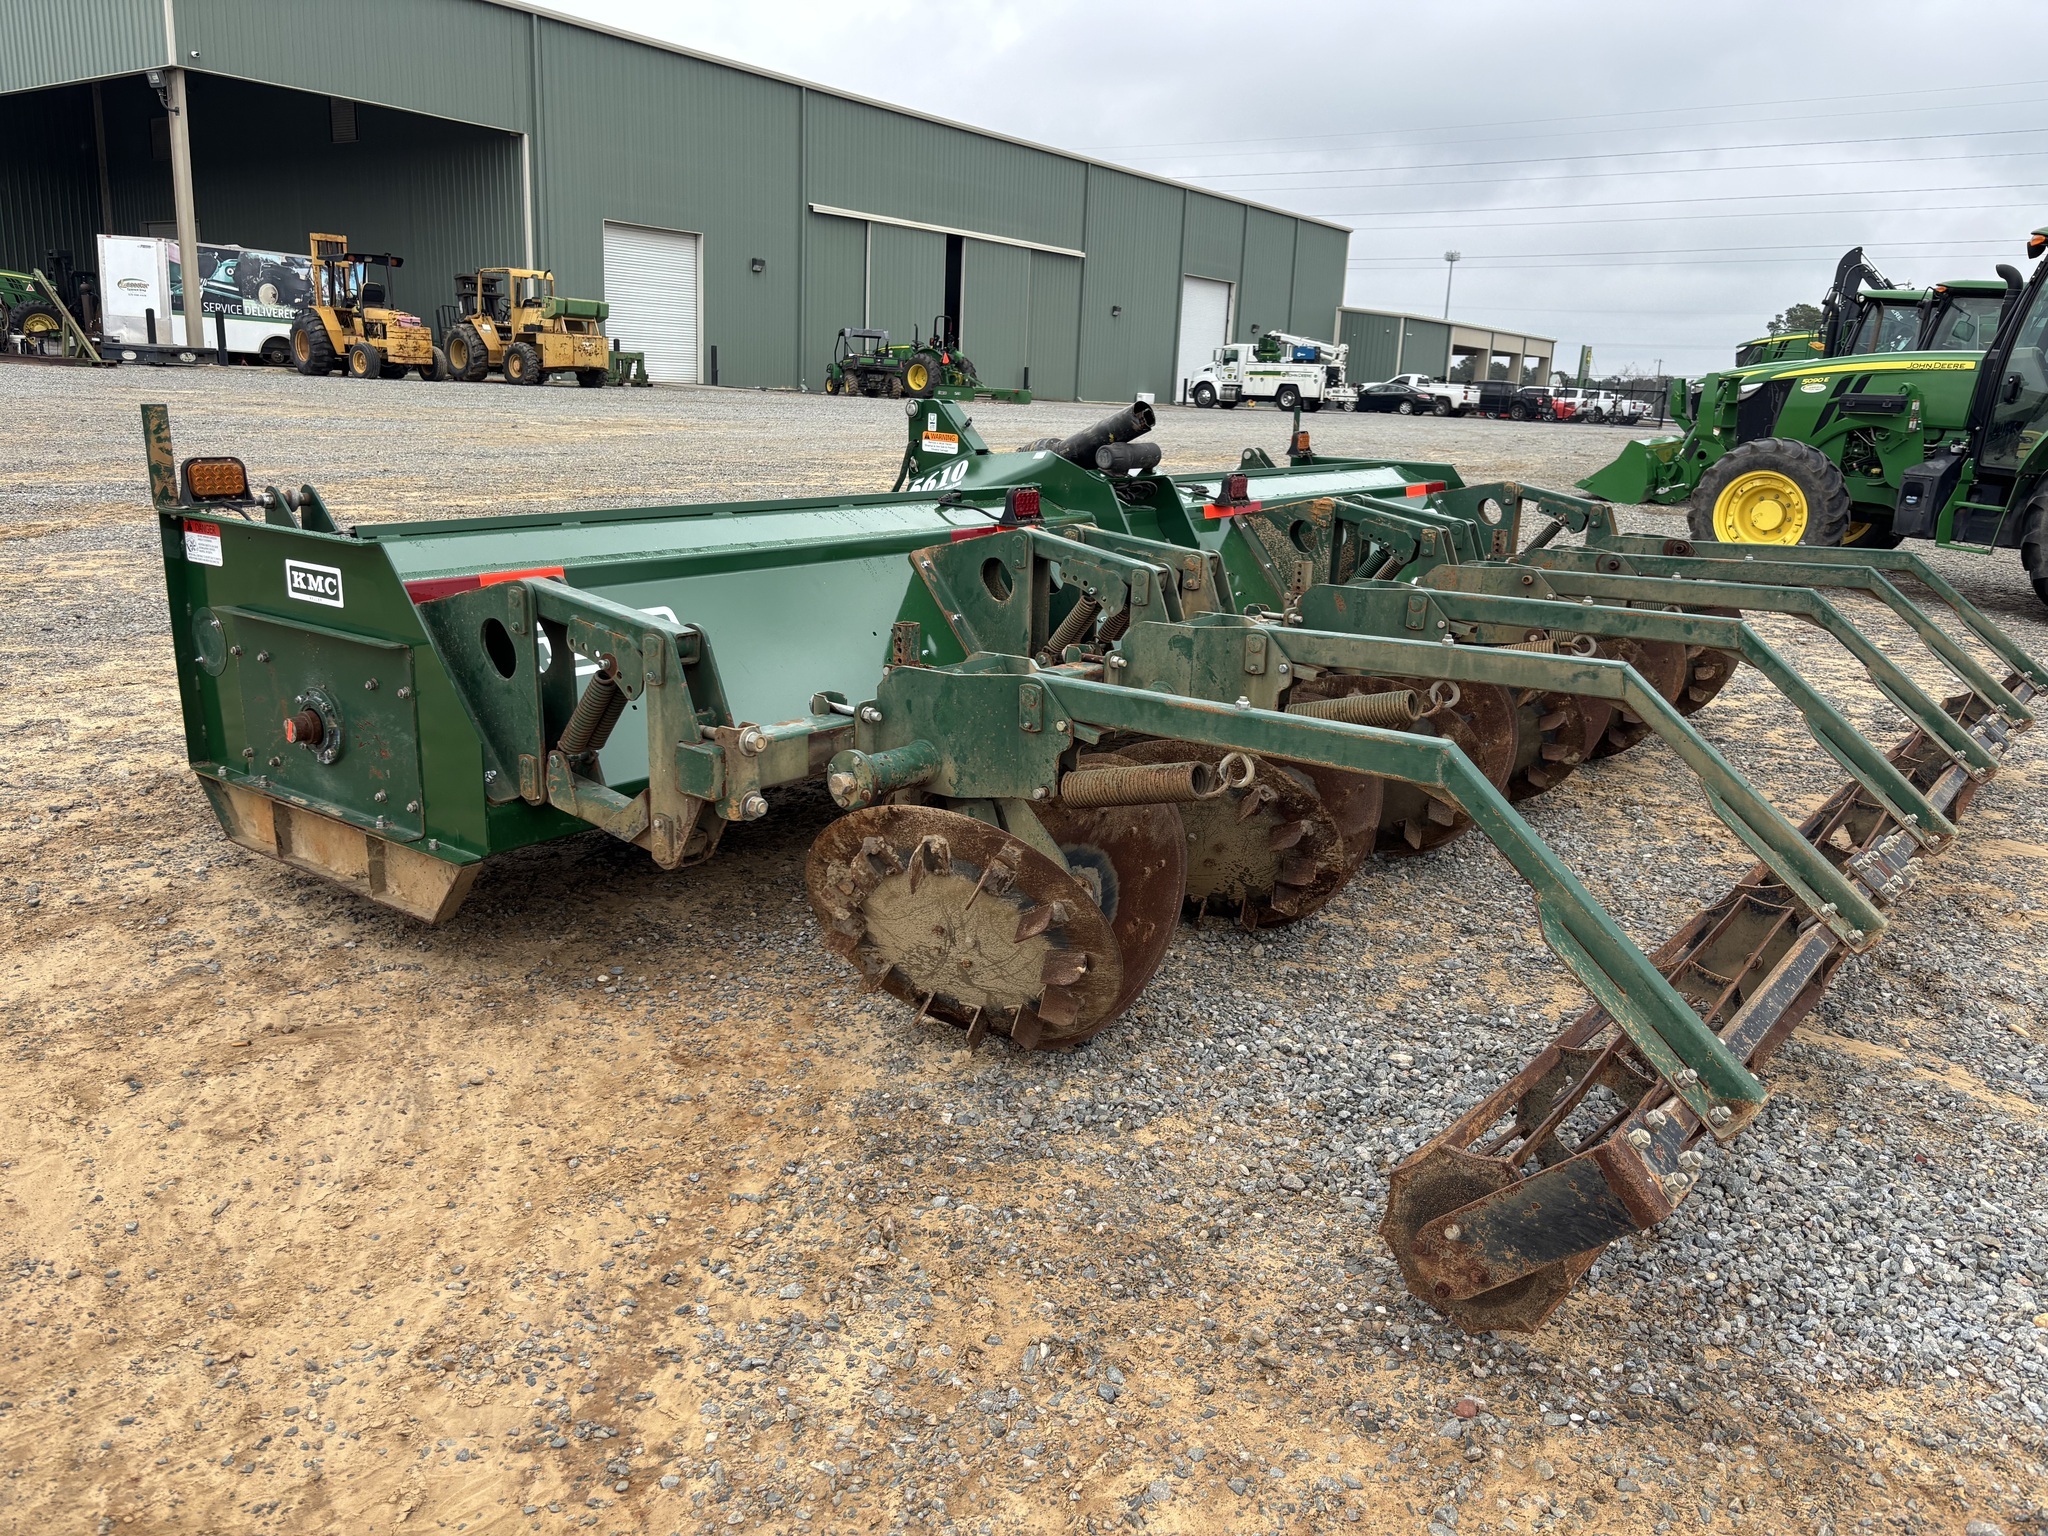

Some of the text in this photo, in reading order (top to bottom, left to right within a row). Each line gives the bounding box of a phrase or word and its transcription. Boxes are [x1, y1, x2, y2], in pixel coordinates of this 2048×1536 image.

[203, 302, 243, 315] SERVICE
[1801, 377, 1823, 385] 5090
[930, 432, 956, 442] WARNING
[909, 459, 969, 492] 5610
[194, 522, 217, 535] DANGER
[291, 570, 338, 596] KMC
